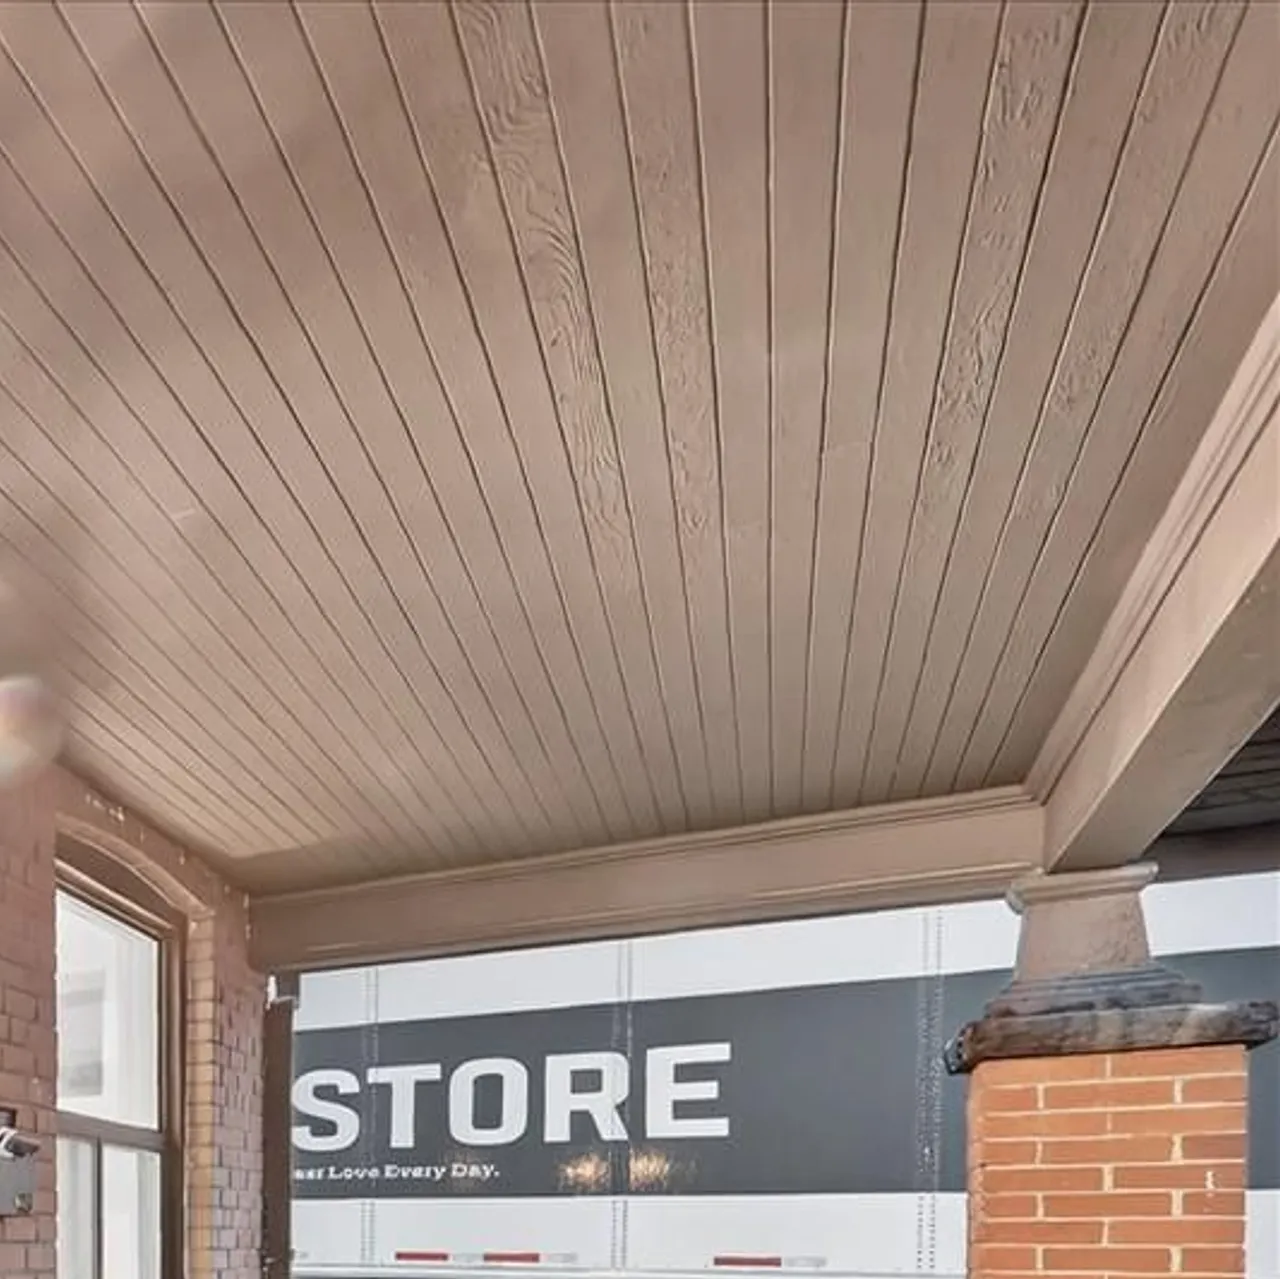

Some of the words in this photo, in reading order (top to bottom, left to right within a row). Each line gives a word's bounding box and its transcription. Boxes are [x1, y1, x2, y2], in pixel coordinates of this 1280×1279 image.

[291, 1042, 732, 1152] STORE
[328, 1165, 380, 1180] Love
[384, 1163, 447, 1182] Every
